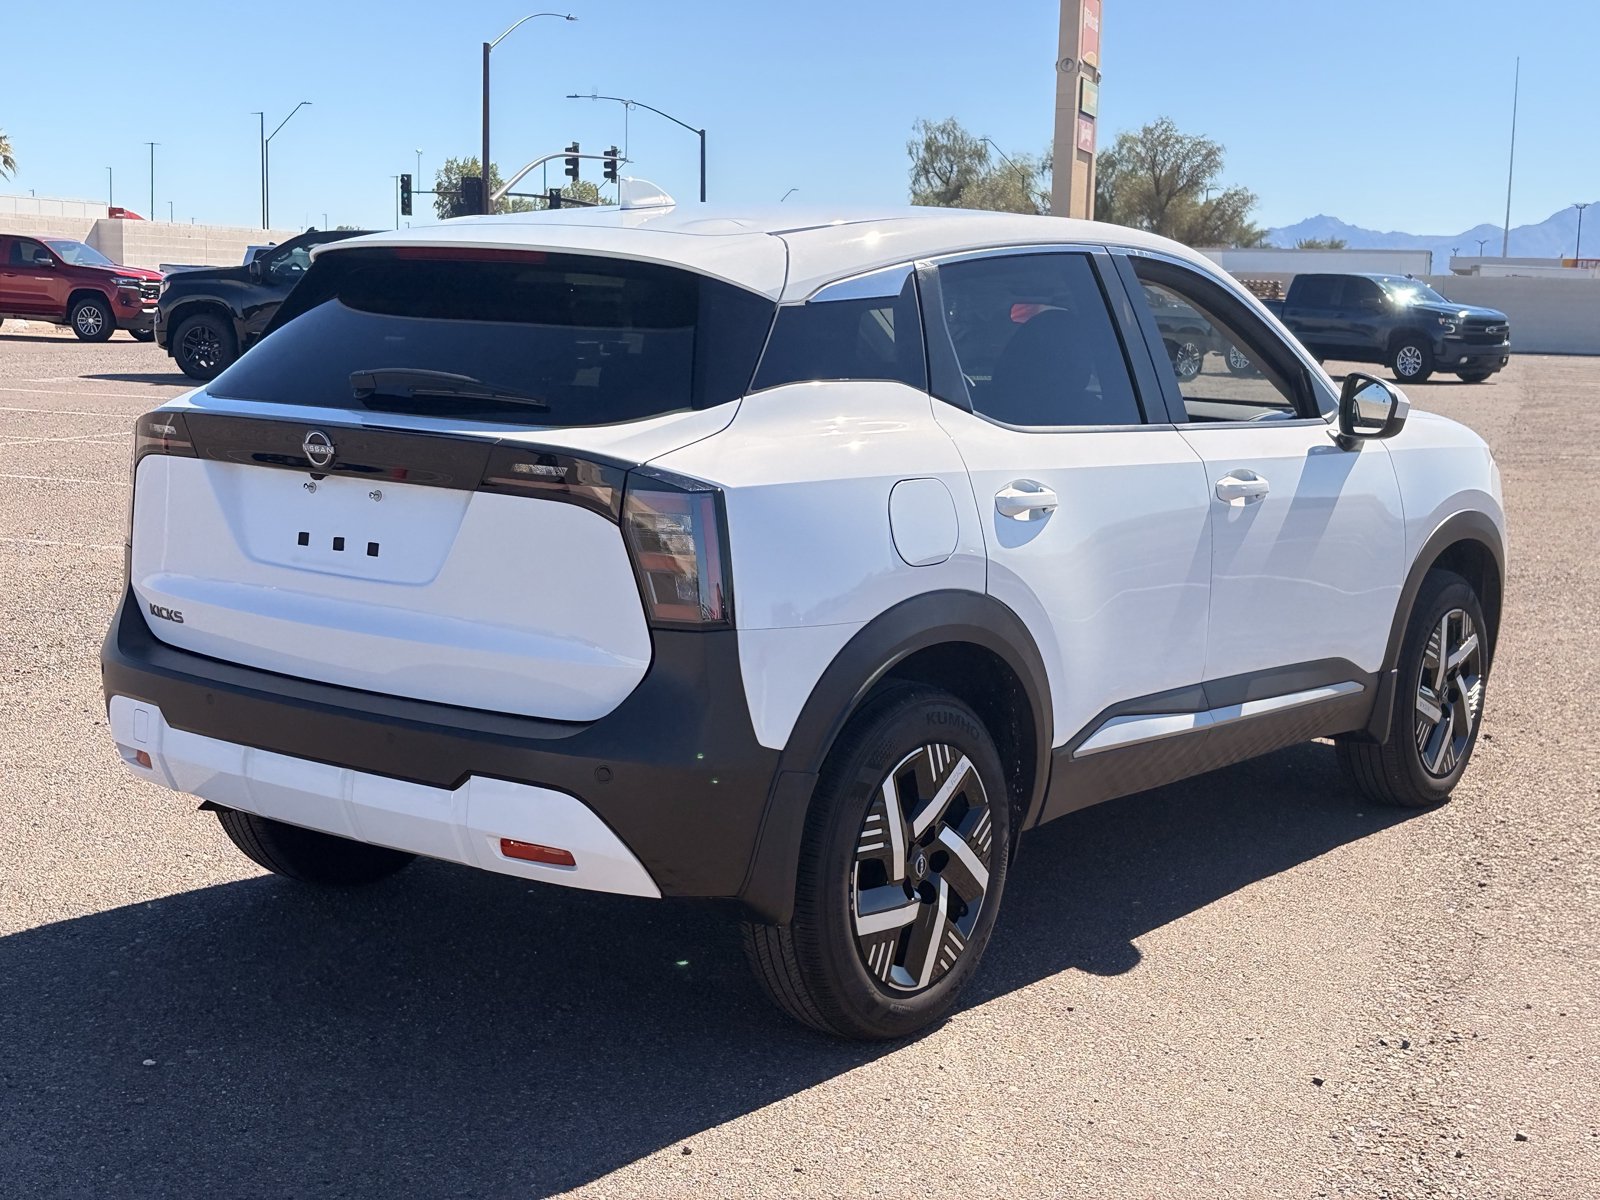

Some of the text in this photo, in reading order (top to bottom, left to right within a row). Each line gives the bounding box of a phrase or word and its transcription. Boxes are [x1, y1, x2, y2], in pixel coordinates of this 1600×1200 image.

[303, 444, 334, 454] NISSAN
[150, 603, 184, 623] KICKS
[926, 711, 980, 740] KUMHO
